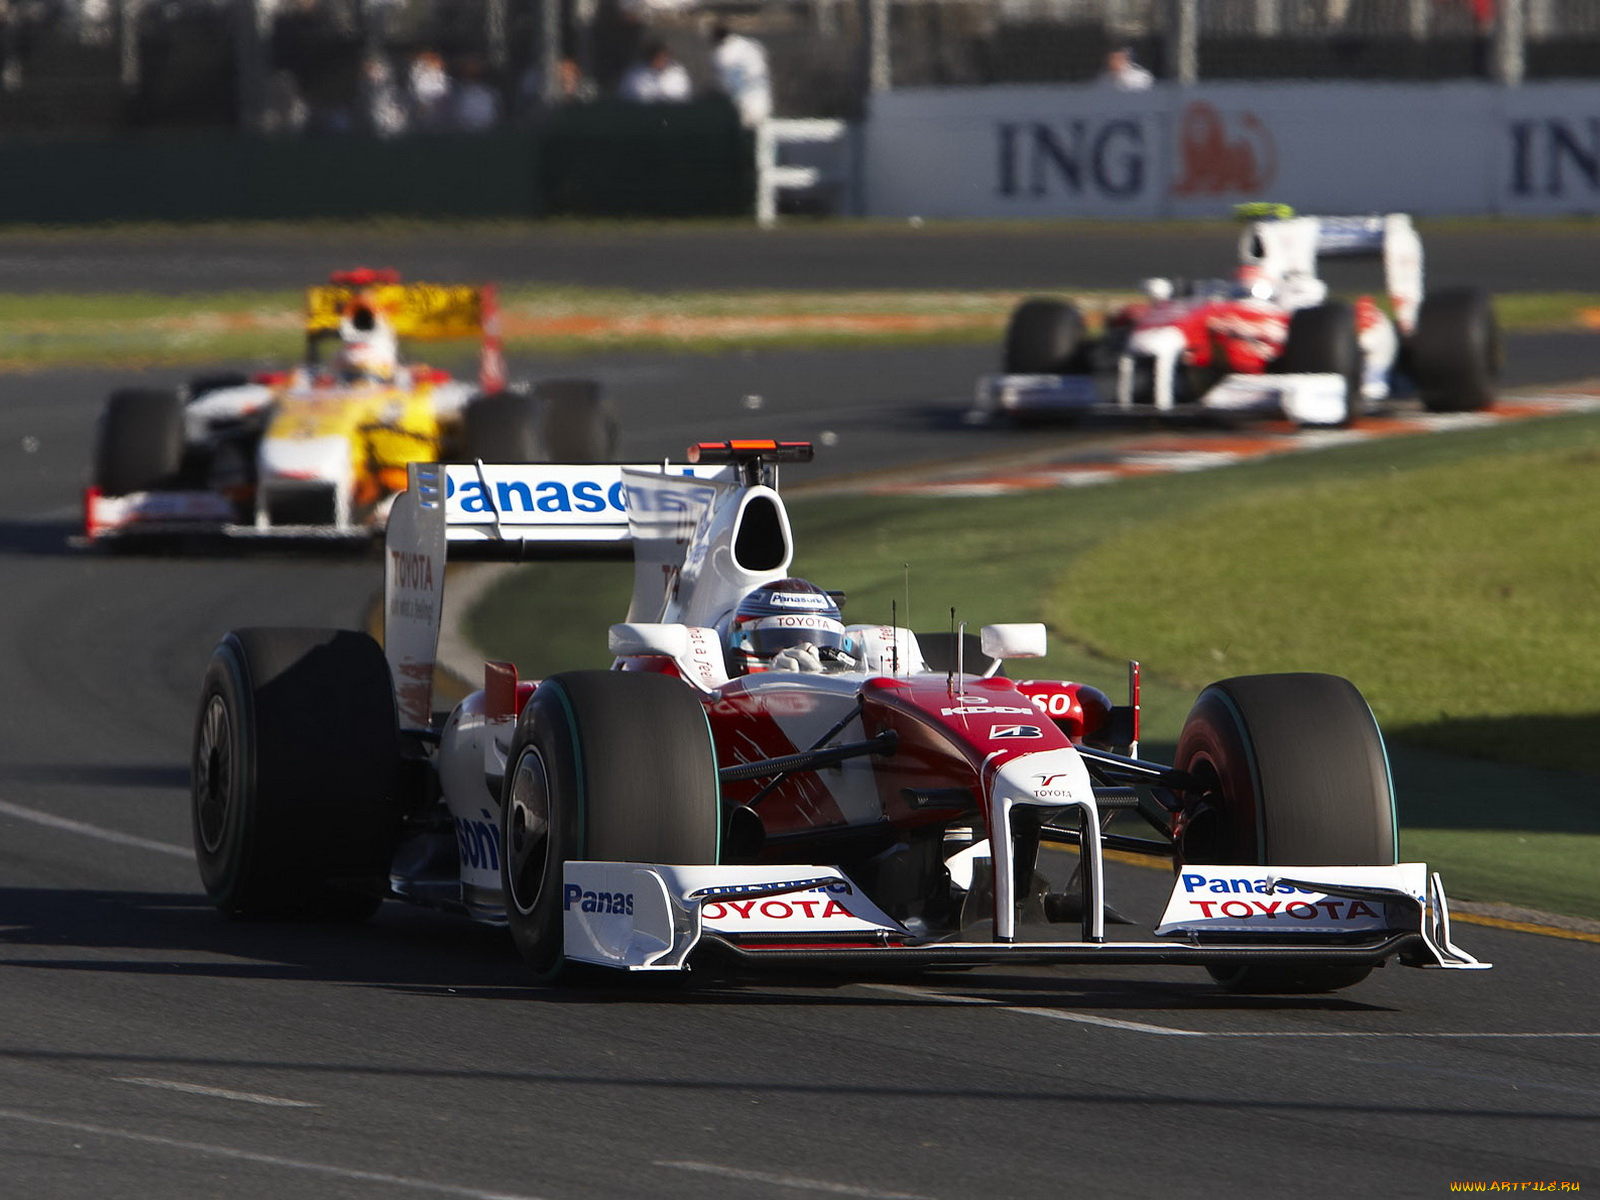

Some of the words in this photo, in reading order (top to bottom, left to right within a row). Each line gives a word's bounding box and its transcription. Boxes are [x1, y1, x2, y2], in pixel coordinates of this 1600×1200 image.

[997, 119, 1147, 199] ING
[1508, 118, 1600, 198] IN
[392, 551, 433, 591] TOYOTA
[777, 616, 830, 630] TOYOTA
[941, 706, 1034, 716] KDDI
[1034, 790, 1072, 798] TOYOTA
[702, 901, 855, 920] OYOTA
[1189, 901, 1380, 920] TOYOTA
